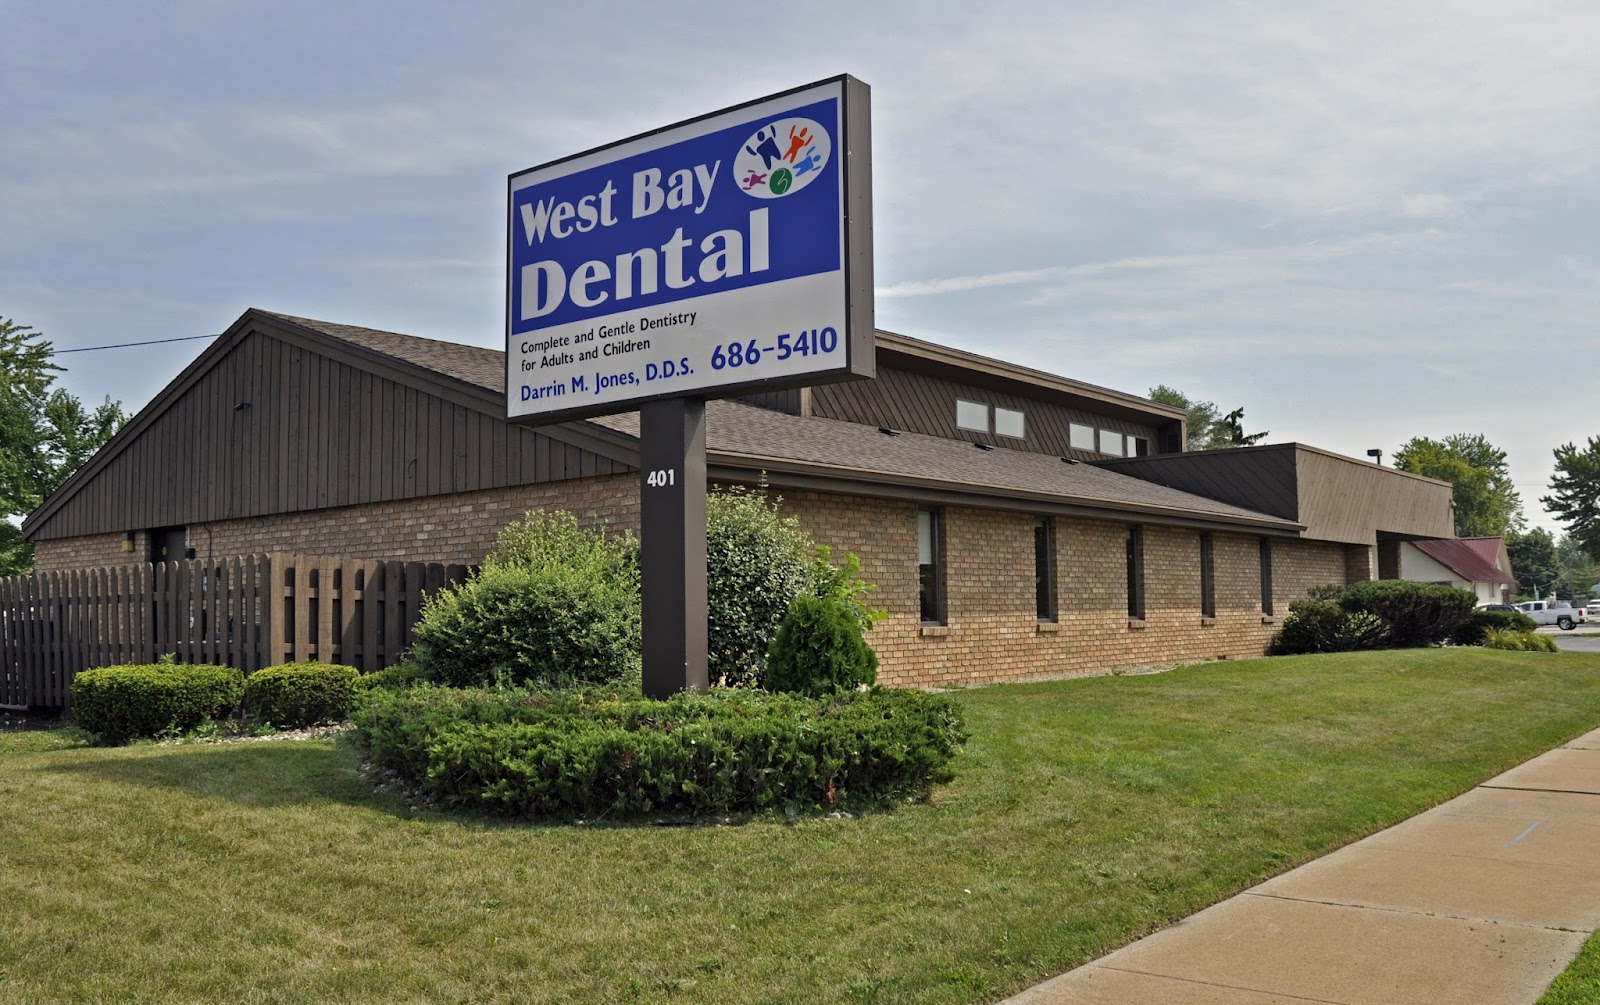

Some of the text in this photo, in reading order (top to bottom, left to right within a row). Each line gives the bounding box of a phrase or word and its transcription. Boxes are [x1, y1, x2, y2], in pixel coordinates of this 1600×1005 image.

[520, 159, 721, 246] West Bay
[520, 206, 769, 321] Dental
[520, 311, 697, 354] Complete and Gentle Dentistry
[710, 326, 838, 370] 686-5410
[521, 339, 651, 371] for Adults and Children
[520, 357, 694, 401] Darrin M. Jones, D.D.S.
[647, 469, 675, 487] 401
